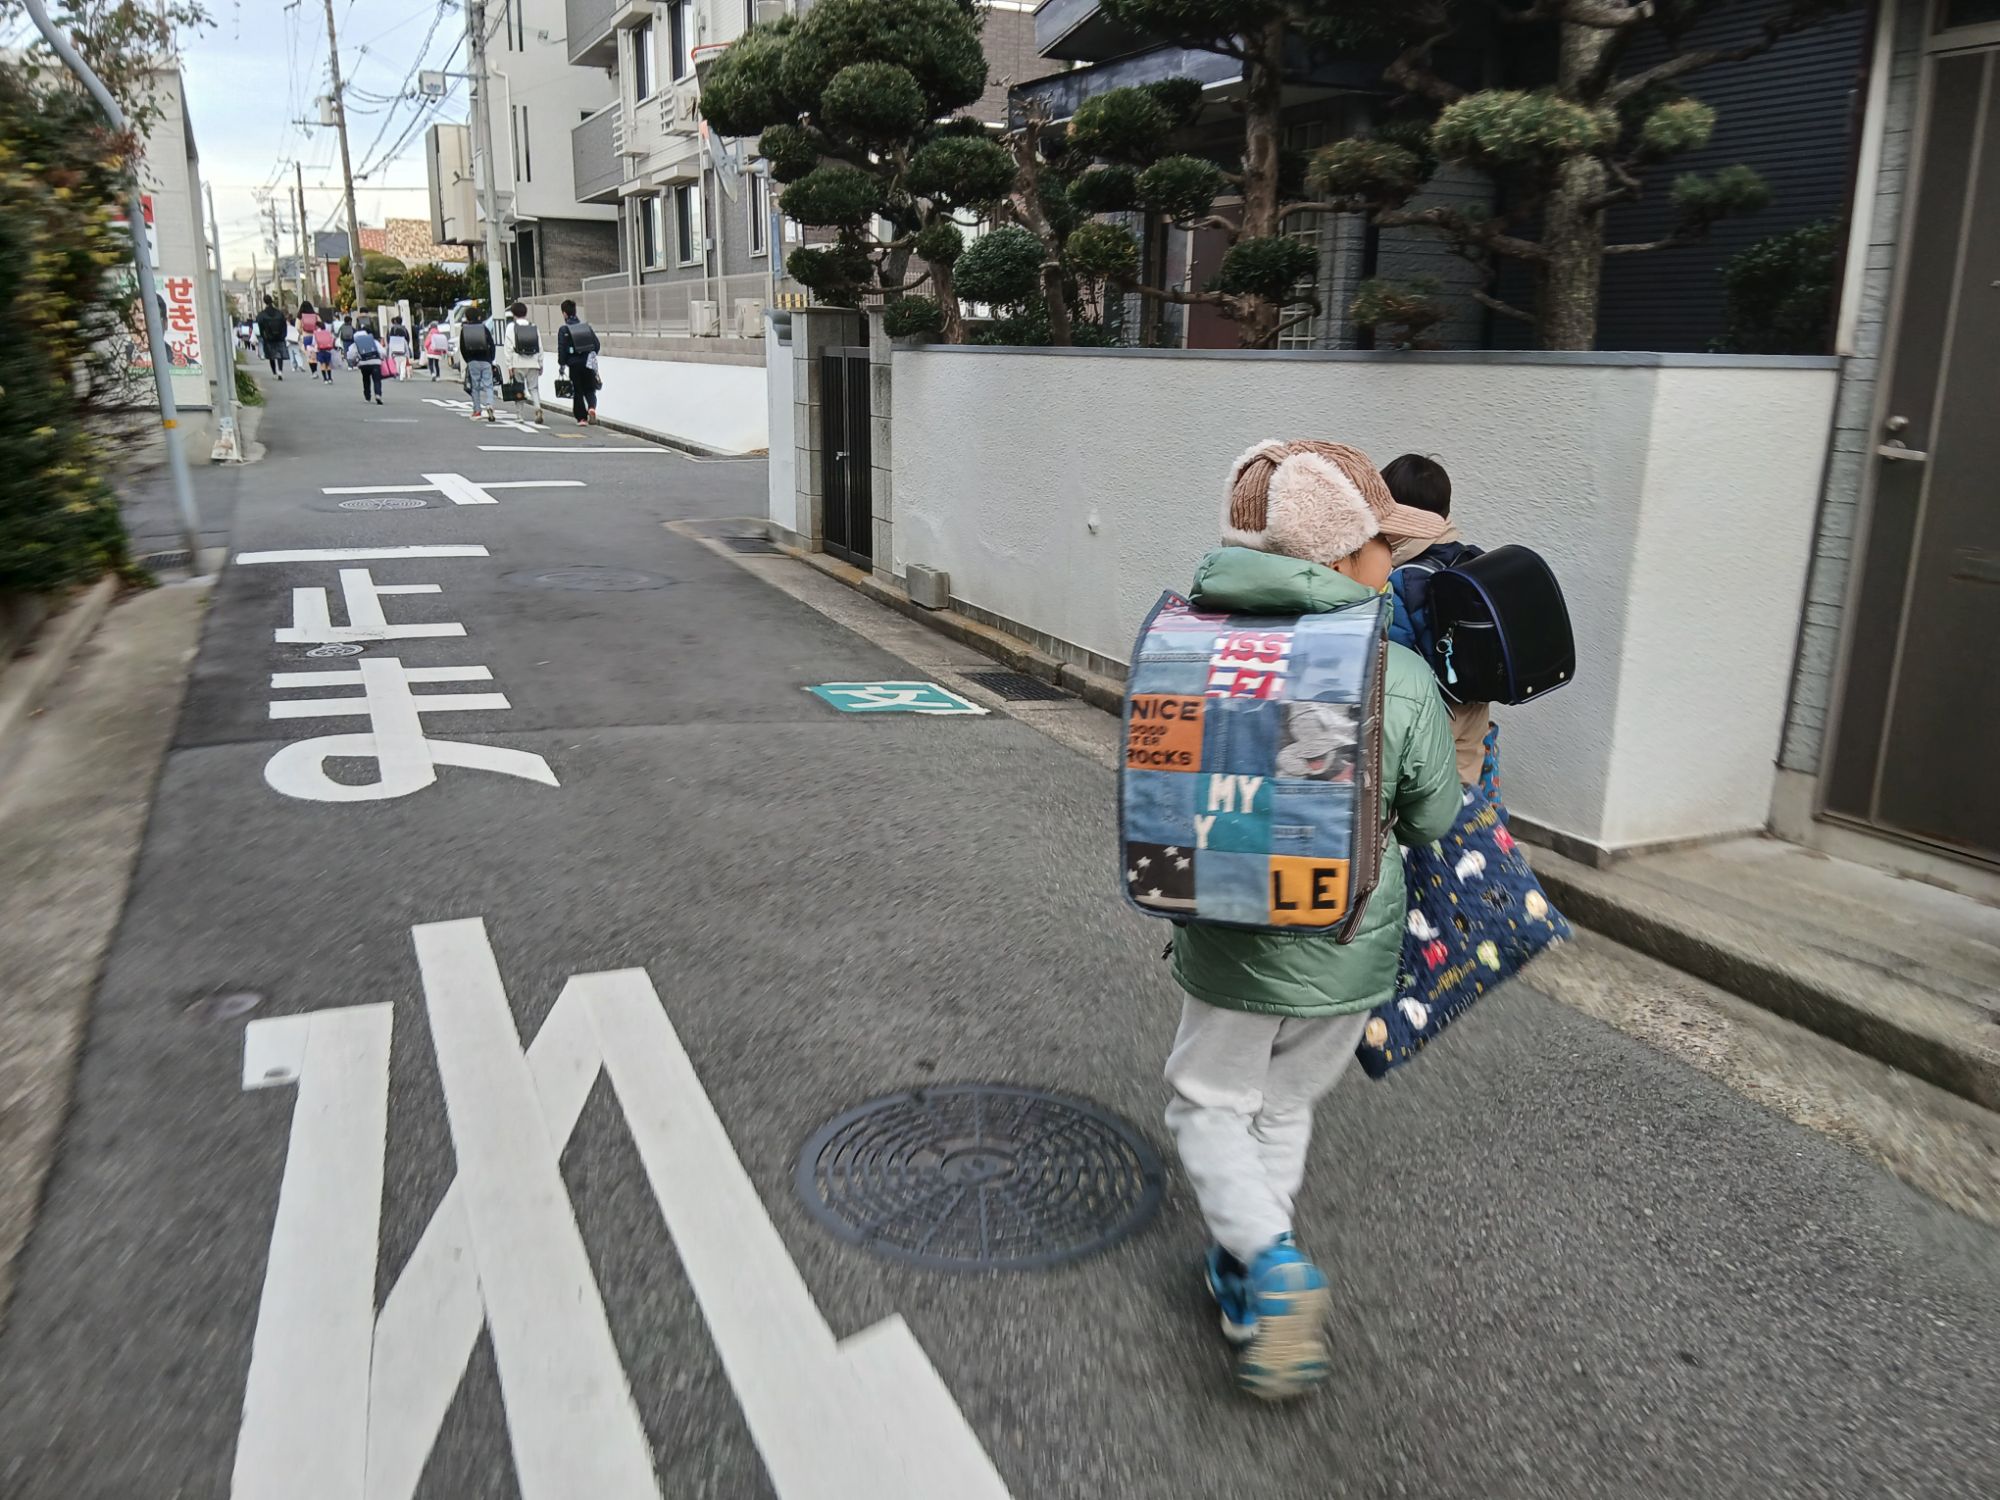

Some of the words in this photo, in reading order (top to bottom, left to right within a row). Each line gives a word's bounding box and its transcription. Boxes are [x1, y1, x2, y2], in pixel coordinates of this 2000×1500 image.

[165, 277, 195, 332] せき
[1131, 699, 1201, 721] NICE
[1207, 773, 1264, 814] MY
[1193, 813, 1217, 850] Y
